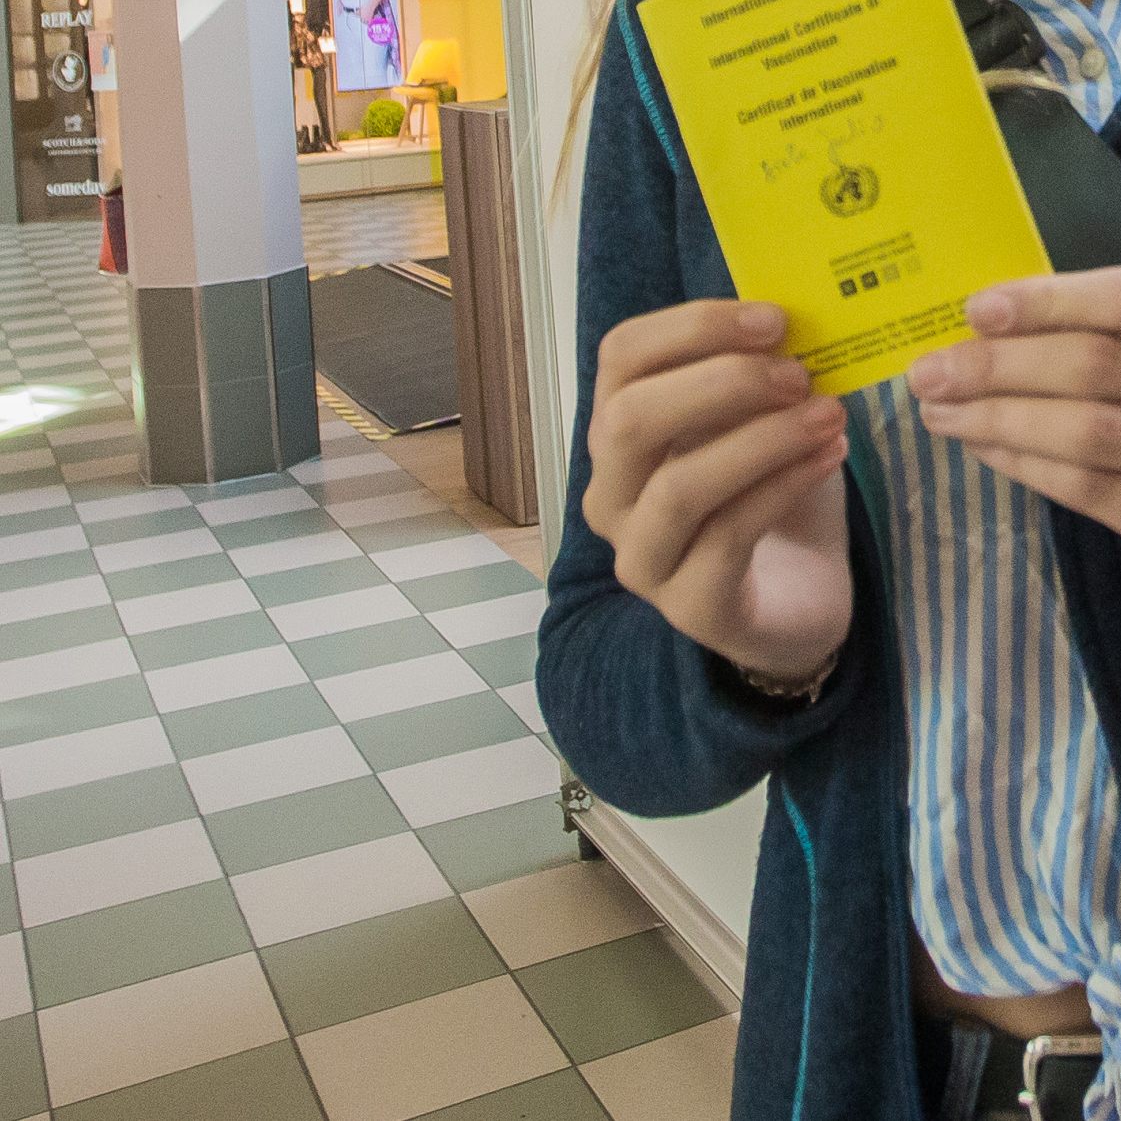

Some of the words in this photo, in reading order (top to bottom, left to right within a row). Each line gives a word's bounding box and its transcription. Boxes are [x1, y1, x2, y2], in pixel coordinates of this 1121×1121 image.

[41, 10, 93, 29] REPLAY
[794, 2, 863, 37] Certificate
[761, 34, 838, 71] Vaccination
